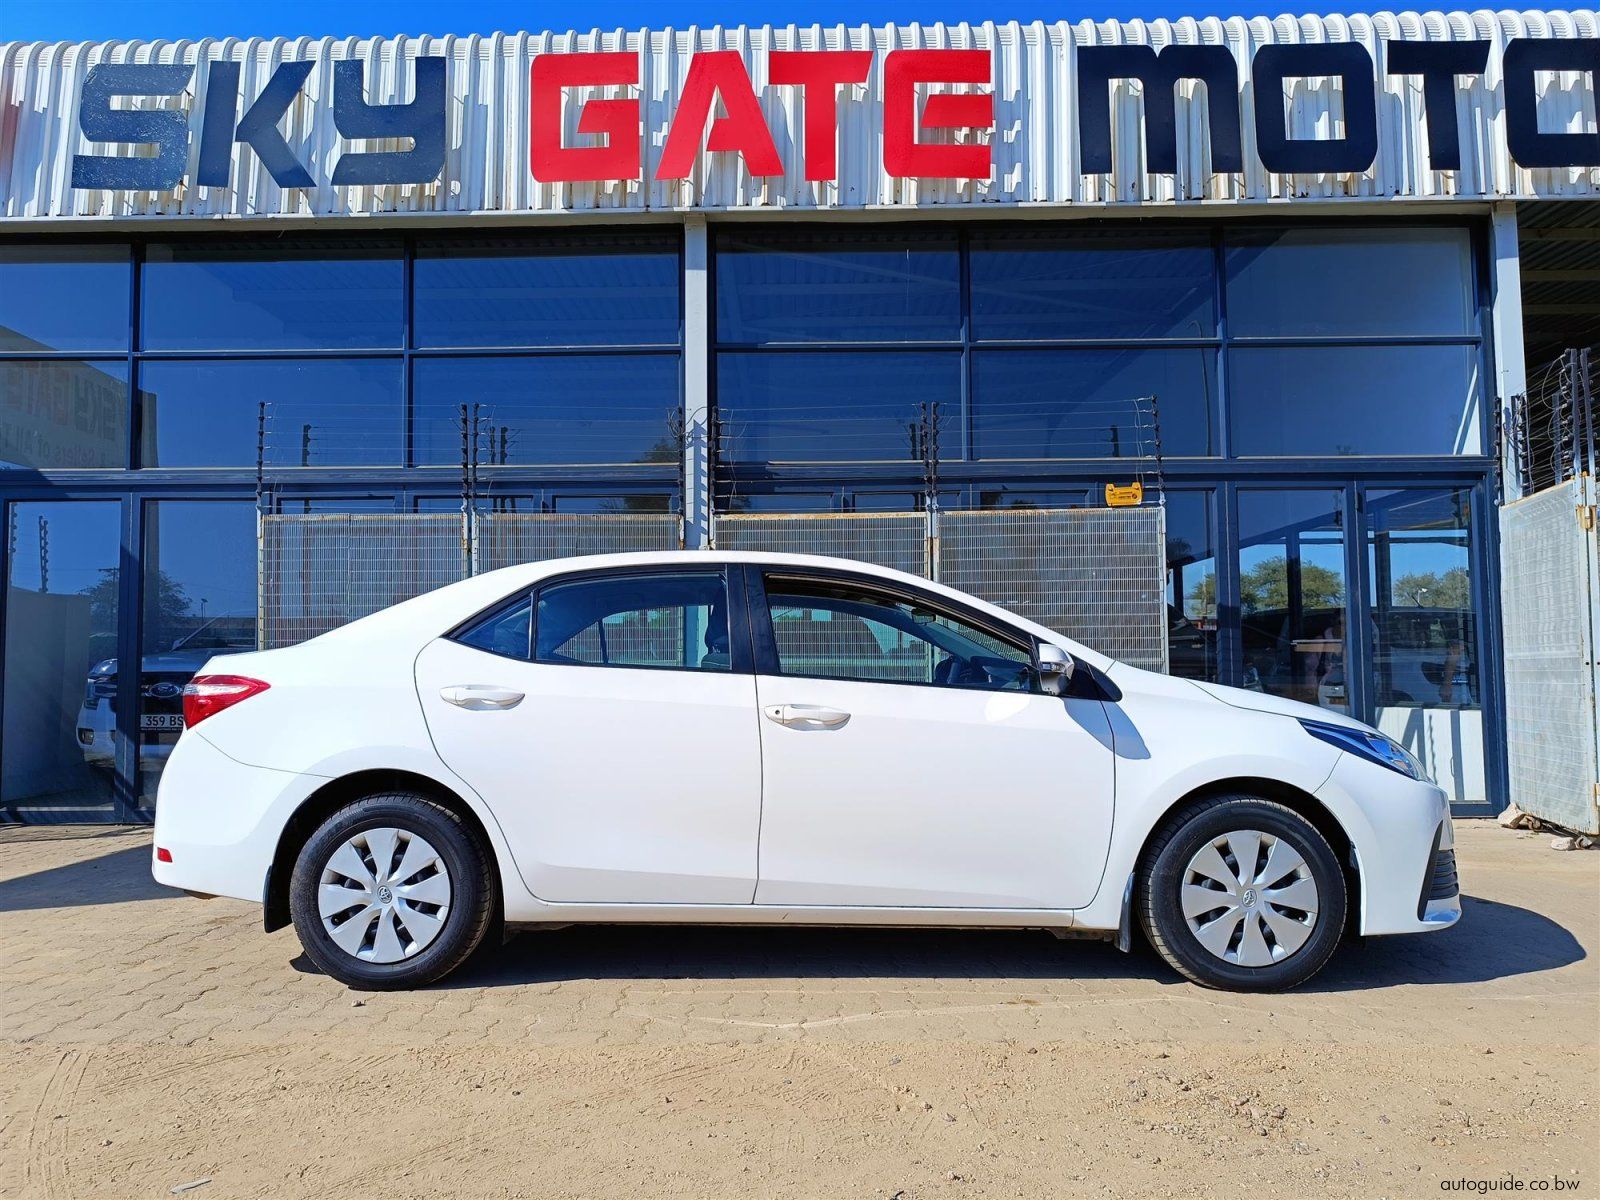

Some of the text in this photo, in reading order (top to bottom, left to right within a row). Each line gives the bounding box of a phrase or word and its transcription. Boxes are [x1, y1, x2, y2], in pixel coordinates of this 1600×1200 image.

[71, 37, 1600, 190] SKY GATE MOTO
[145, 715, 166, 726] 359
